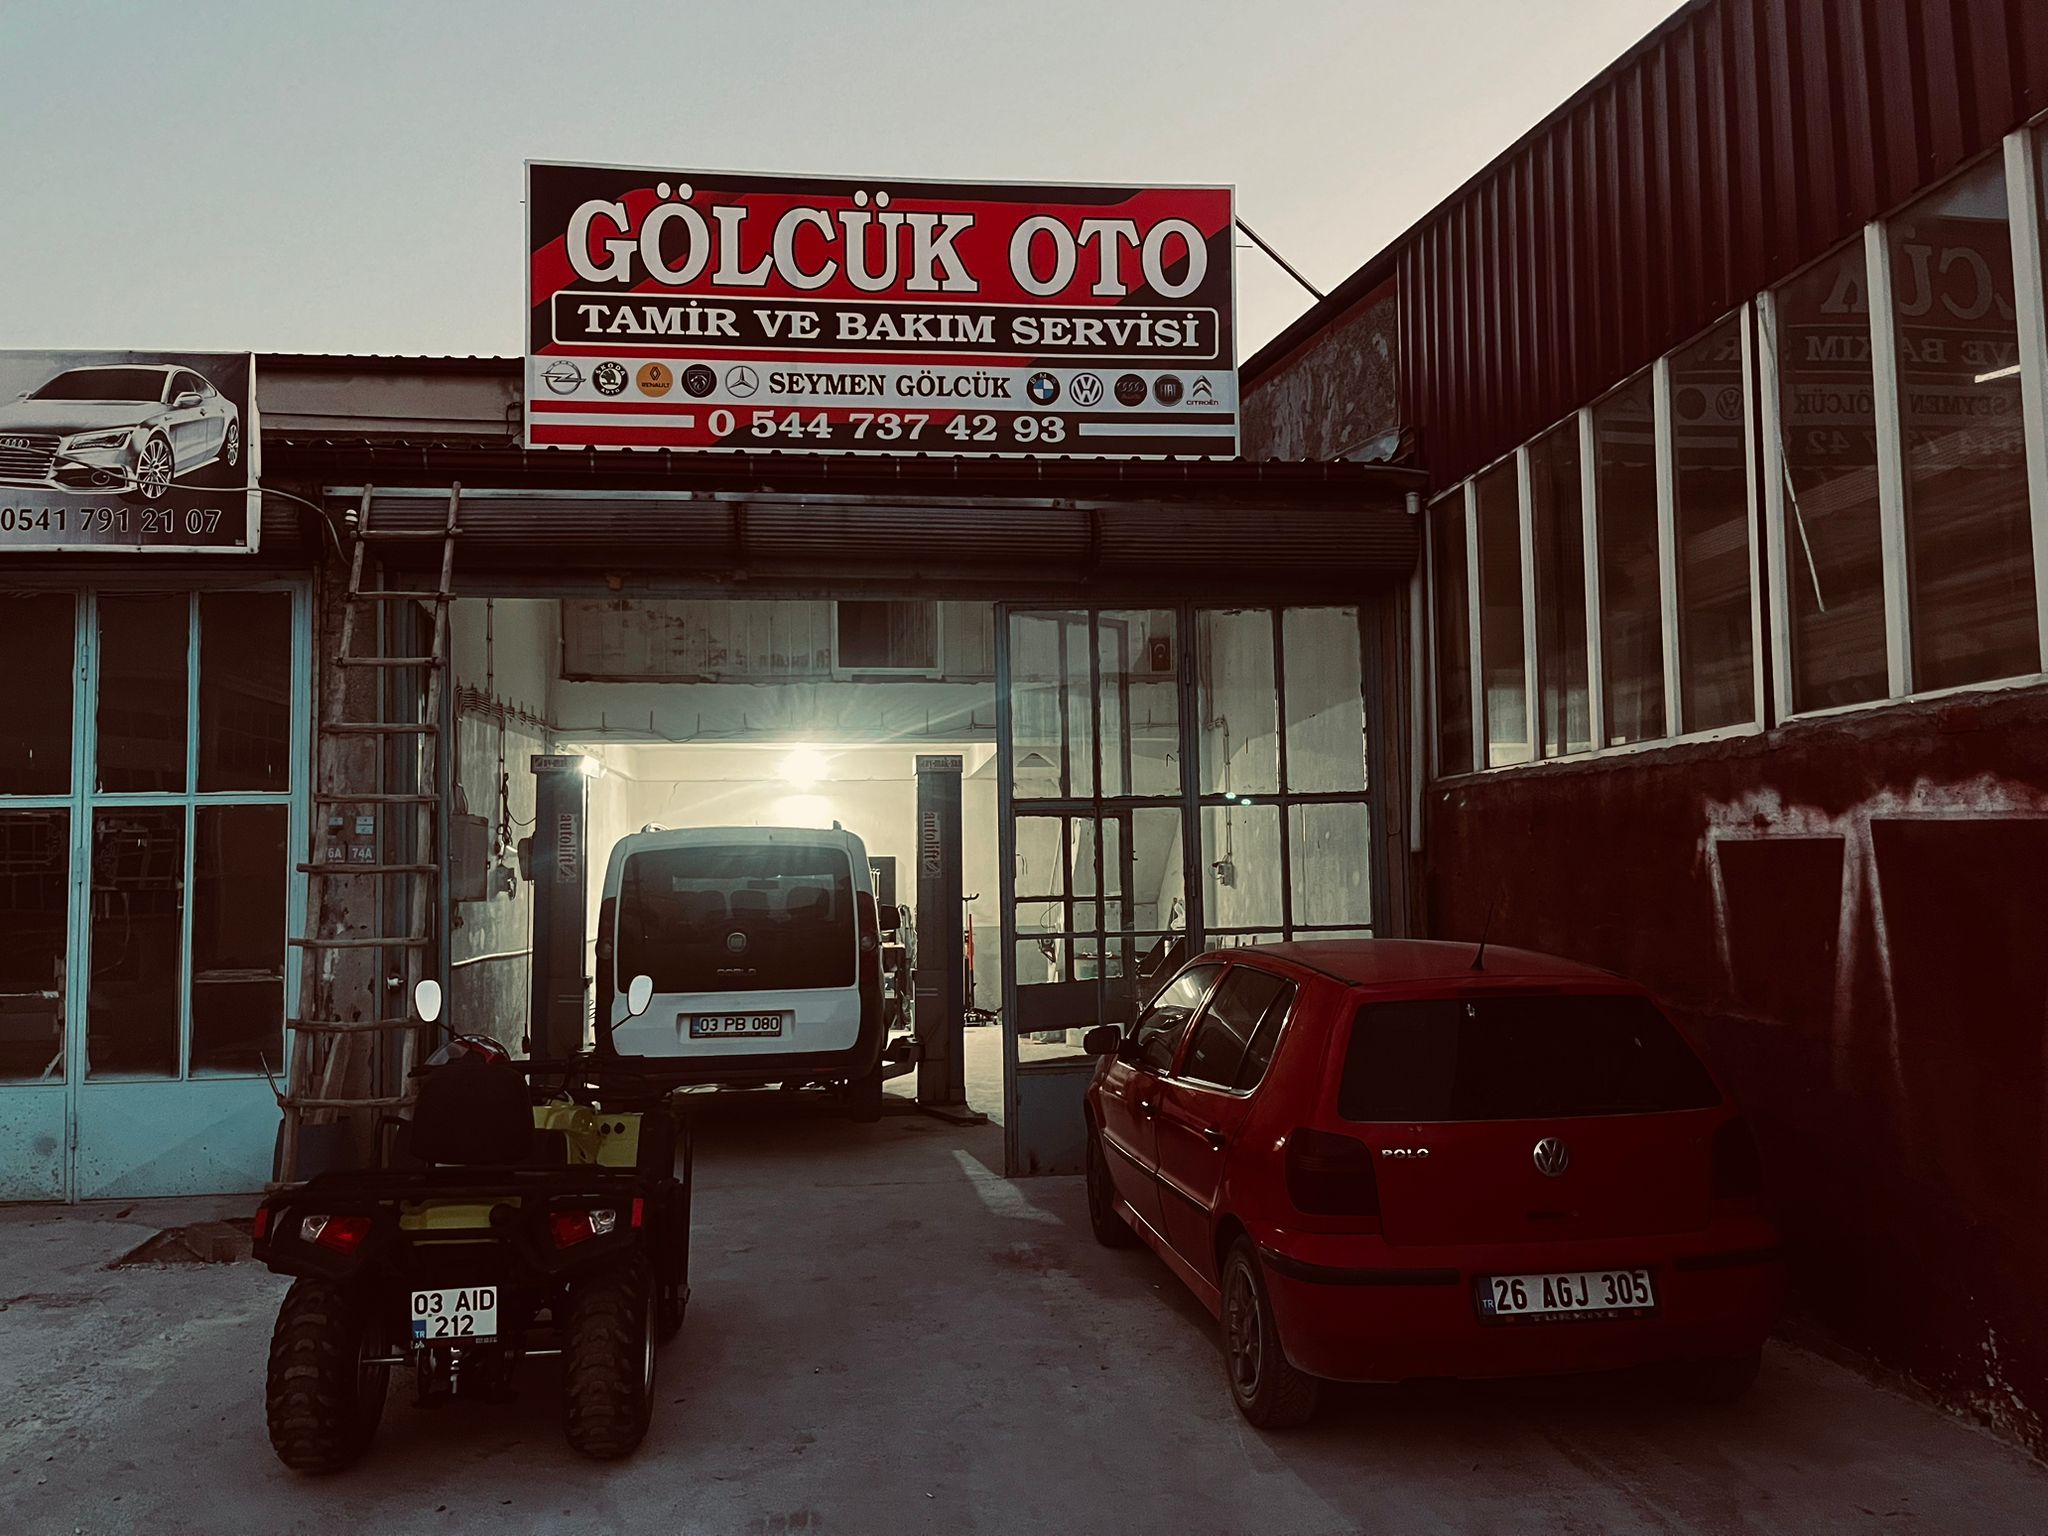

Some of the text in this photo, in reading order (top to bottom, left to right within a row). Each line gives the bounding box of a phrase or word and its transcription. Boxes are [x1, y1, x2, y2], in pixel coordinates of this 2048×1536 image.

[566, 182, 1208, 299] GÖLCÜK OTO
[577, 301, 1201, 348] TAMİR VE BAKIM SERVİSİ
[641, 381, 671, 389] RENAULT
[769, 369, 1012, 399] SEYMEN GÖLCÜK
[707, 409, 1067, 443] 0 544 737 42 93
[0, 507, 223, 535] 0541 791 21 07
[559, 814, 576, 863] autolift
[924, 811, 940, 859] autolift
[351, 847, 373, 859] 74A
[700, 1018, 718, 1032] 03
[724, 1017, 746, 1031] PB
[752, 1016, 779, 1031] 080
[1381, 1148, 1429, 1159] POLO
[414, 1289, 494, 1315] 03 AID
[1482, 1299, 1495, 1309] TR
[1494, 1272, 1649, 1311] 26 AGJ 305
[414, 1330, 425, 1339] TR
[435, 1314, 474, 1337] 212
